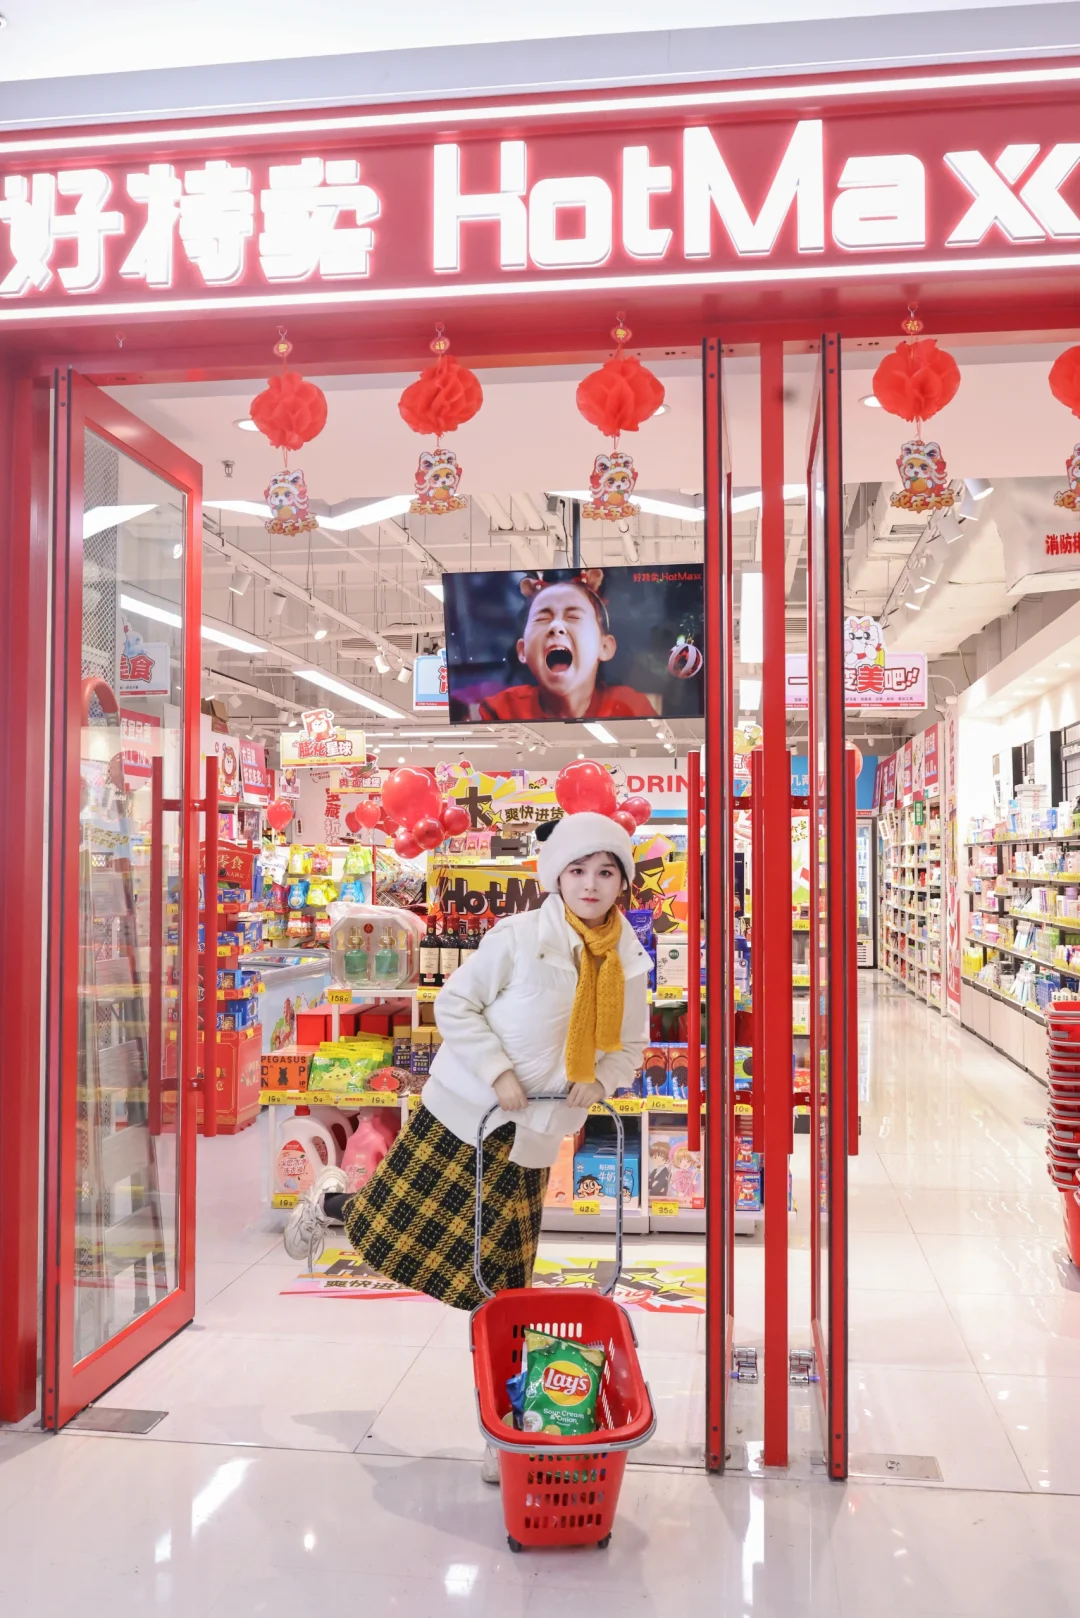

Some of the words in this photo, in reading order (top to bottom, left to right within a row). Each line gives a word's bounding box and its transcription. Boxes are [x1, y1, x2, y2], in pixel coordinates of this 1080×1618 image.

[0, 157, 381, 296] 好特卖
[298, 740, 353, 758] 膨化星球
[505, 805, 564, 822] 爽快进货
[261, 1056, 306, 1064] PEGASUS
[599, 1172, 615, 1183] 牛奶
[545, 1368, 590, 1395] Lay's
[543, 1407, 561, 1416] Sour
[561, 1410, 585, 1420] Cream
[556, 1414, 578, 1424] Onion
